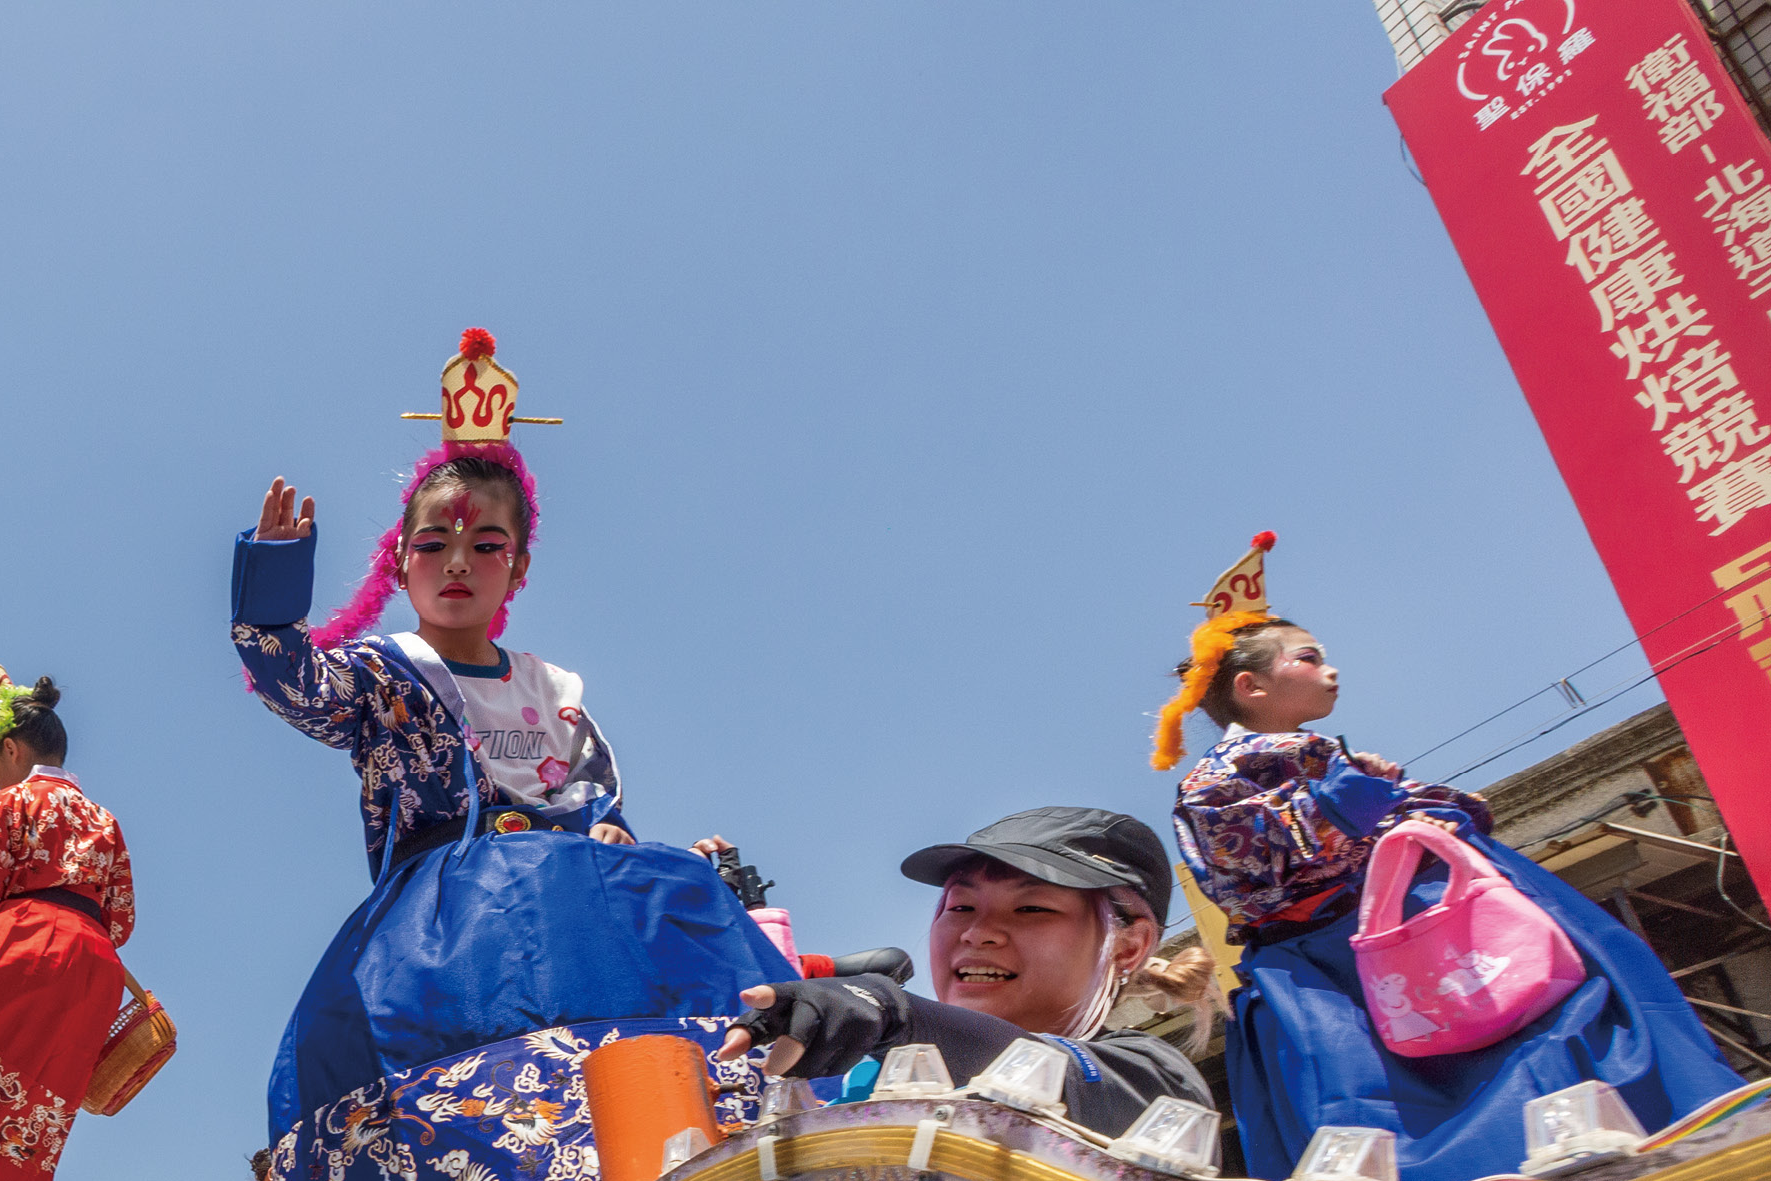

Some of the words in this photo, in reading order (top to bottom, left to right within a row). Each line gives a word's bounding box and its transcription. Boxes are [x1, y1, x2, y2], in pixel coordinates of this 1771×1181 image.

[1458, 11, 1497, 59] SAINT
[1472, 27, 1597, 131] 聖保羅
